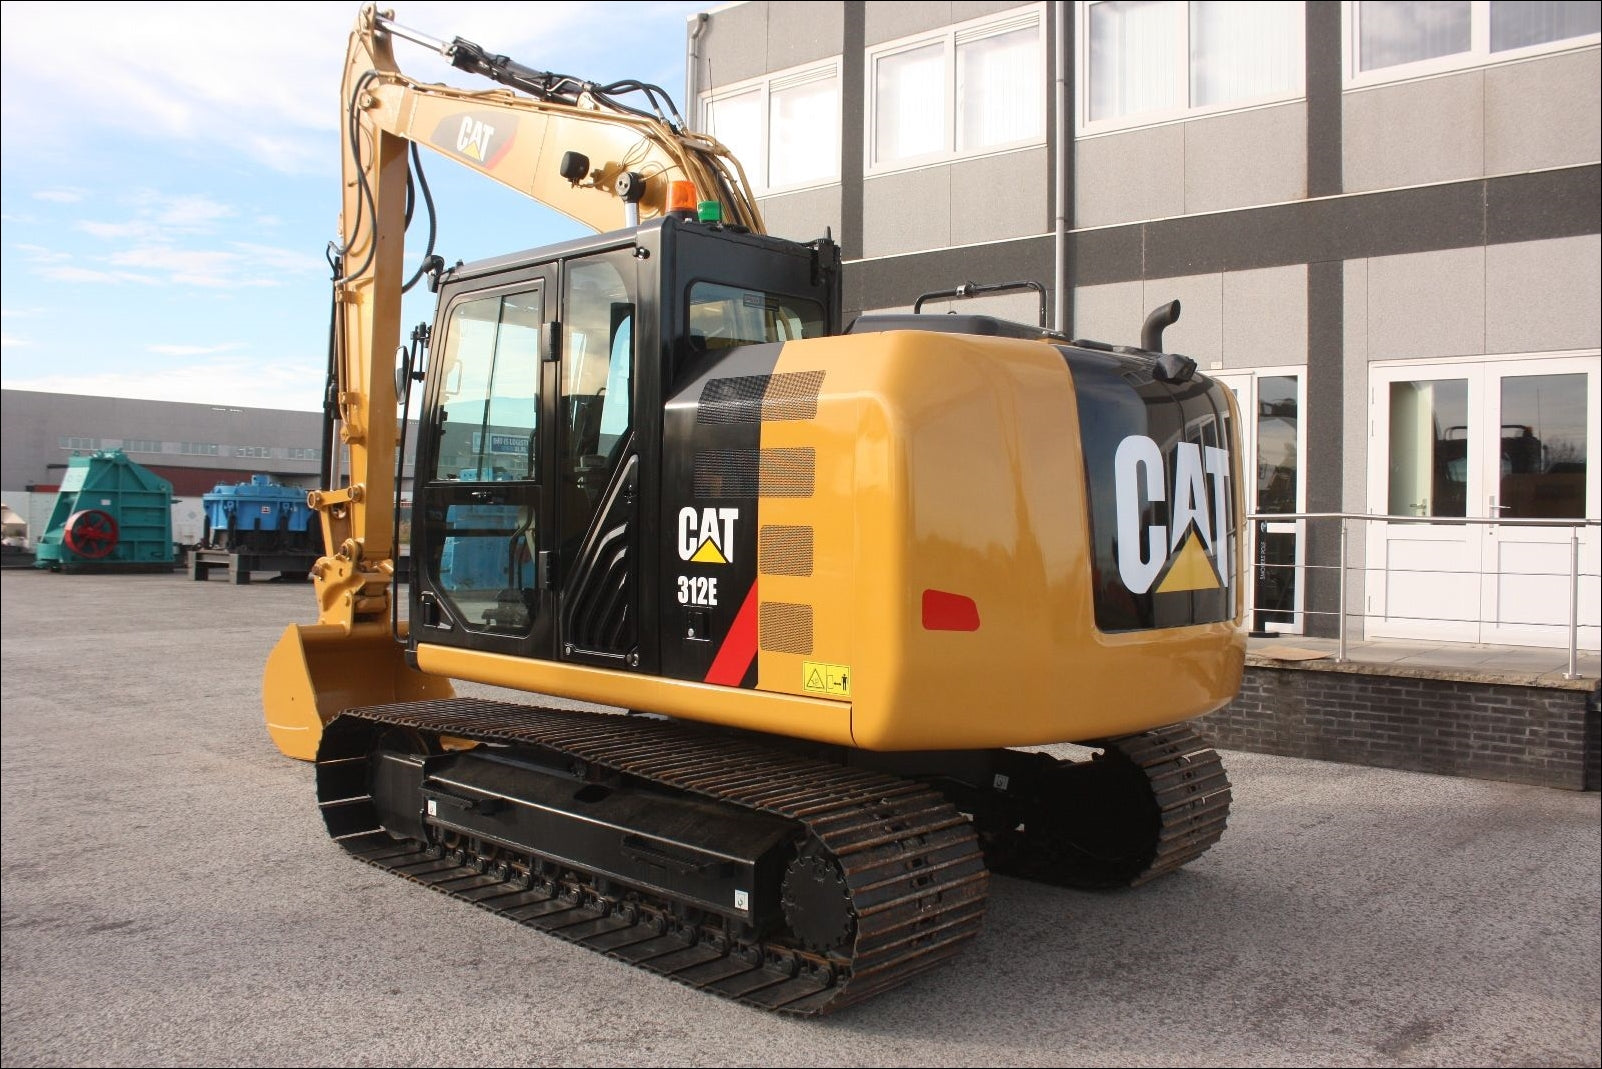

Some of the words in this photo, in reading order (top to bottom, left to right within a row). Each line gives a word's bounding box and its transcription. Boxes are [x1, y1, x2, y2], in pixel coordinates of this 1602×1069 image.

[456, 116, 495, 162] CAT
[678, 506, 739, 563] CAT
[1114, 435, 1230, 595] CAT
[677, 575, 718, 606] 312E
